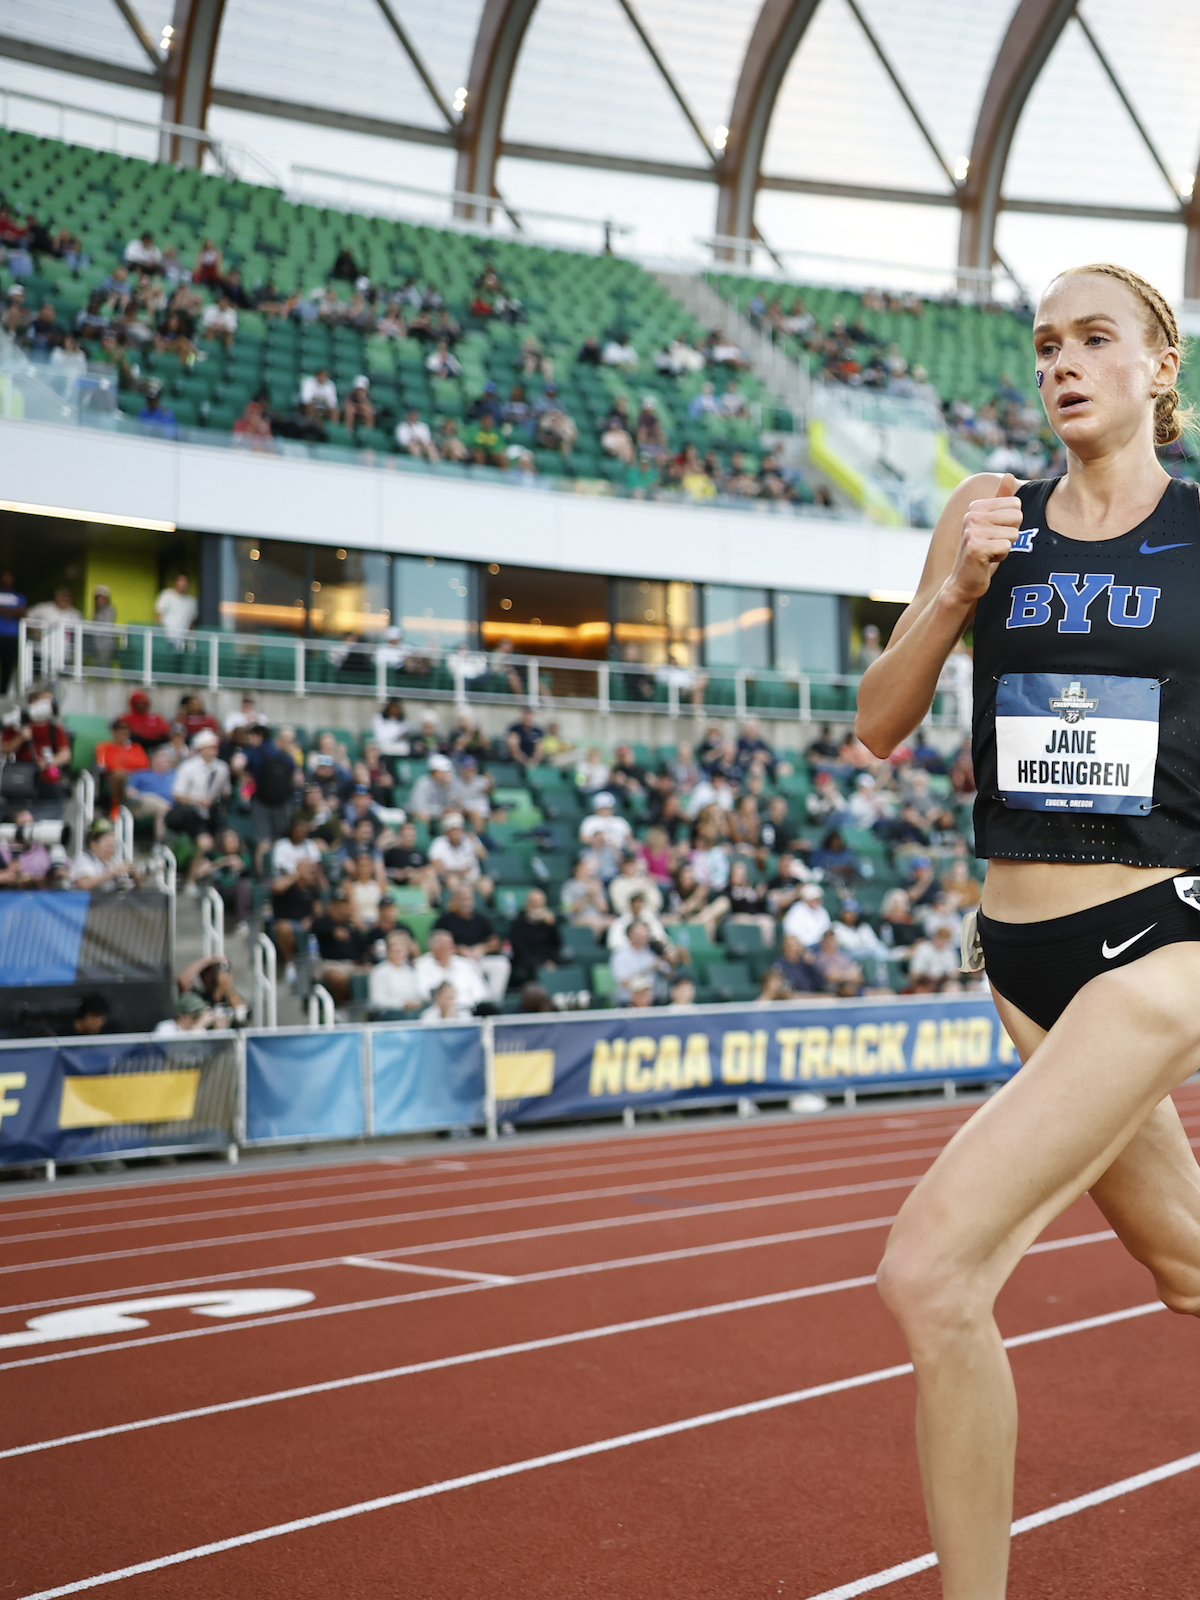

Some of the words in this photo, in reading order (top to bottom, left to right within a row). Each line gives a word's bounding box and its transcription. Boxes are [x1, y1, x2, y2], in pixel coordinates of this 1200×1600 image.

[1006, 572, 1161, 634] BYU
[1045, 729, 1097, 755] JANE
[1017, 759, 1130, 788] HEDENGREN
[1045, 798, 1069, 808] EUGENE,
[1069, 799, 1094, 809] OREGON
[588, 1033, 713, 1097] NCAA
[720, 1029, 769, 1085] DI
[775, 1021, 910, 1082] TRACK
[912, 1015, 993, 1071] AND
